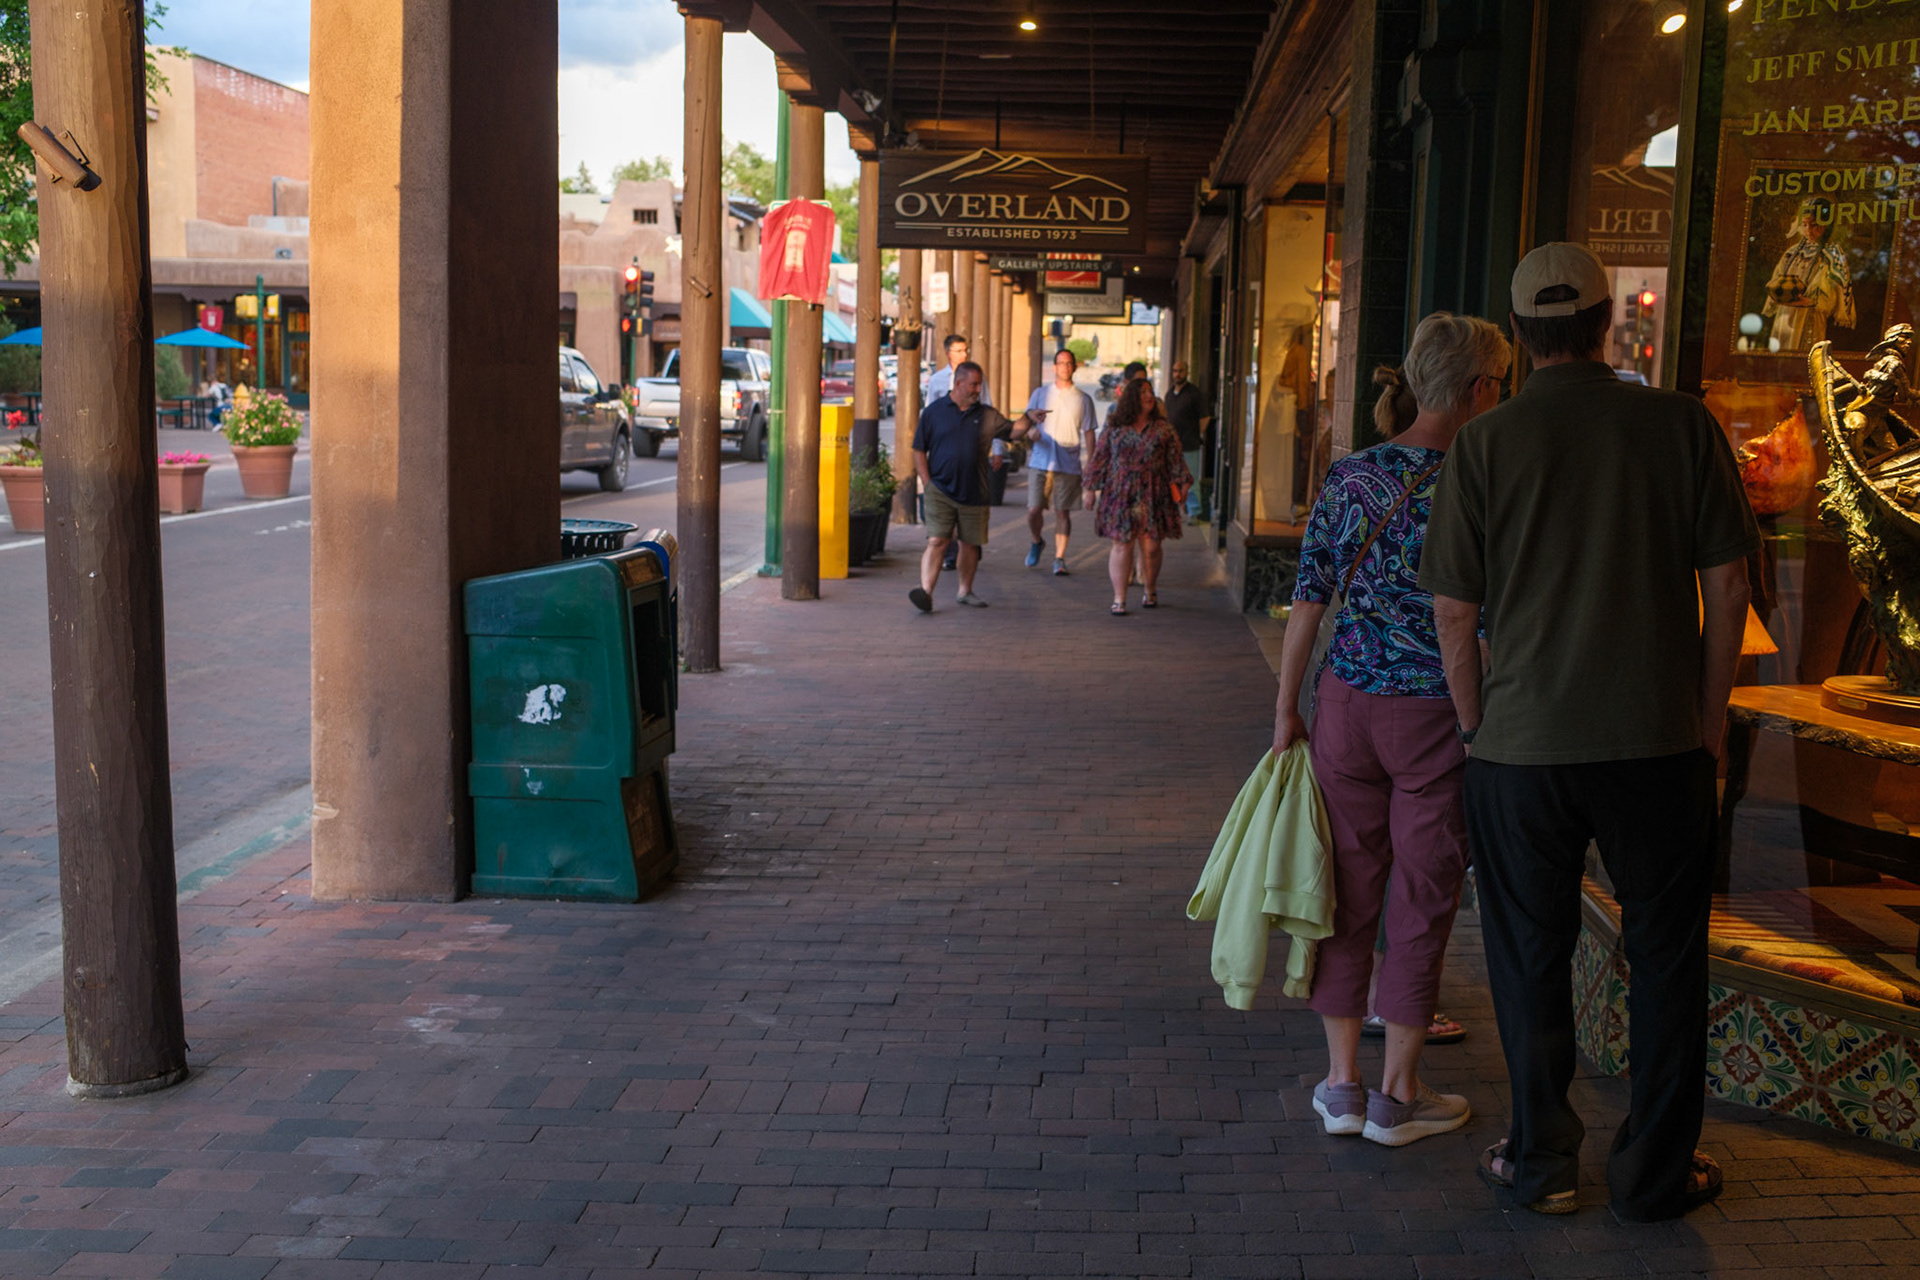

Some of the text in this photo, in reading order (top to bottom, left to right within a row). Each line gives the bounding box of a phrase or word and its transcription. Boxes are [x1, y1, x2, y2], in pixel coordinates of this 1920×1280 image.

[1746, 50, 1826, 84] JEFF
[1742, 107, 1811, 136] JAN
[1744, 163, 1920, 197] CUSTOM DE
[894, 192, 1131, 222] OVERLAND
[947, 227, 1077, 241] ESTABLISHED 1973
[998, 260, 1099, 270] GALLERY UPSTAIRS
[1050, 296, 1081, 307] PINTO
